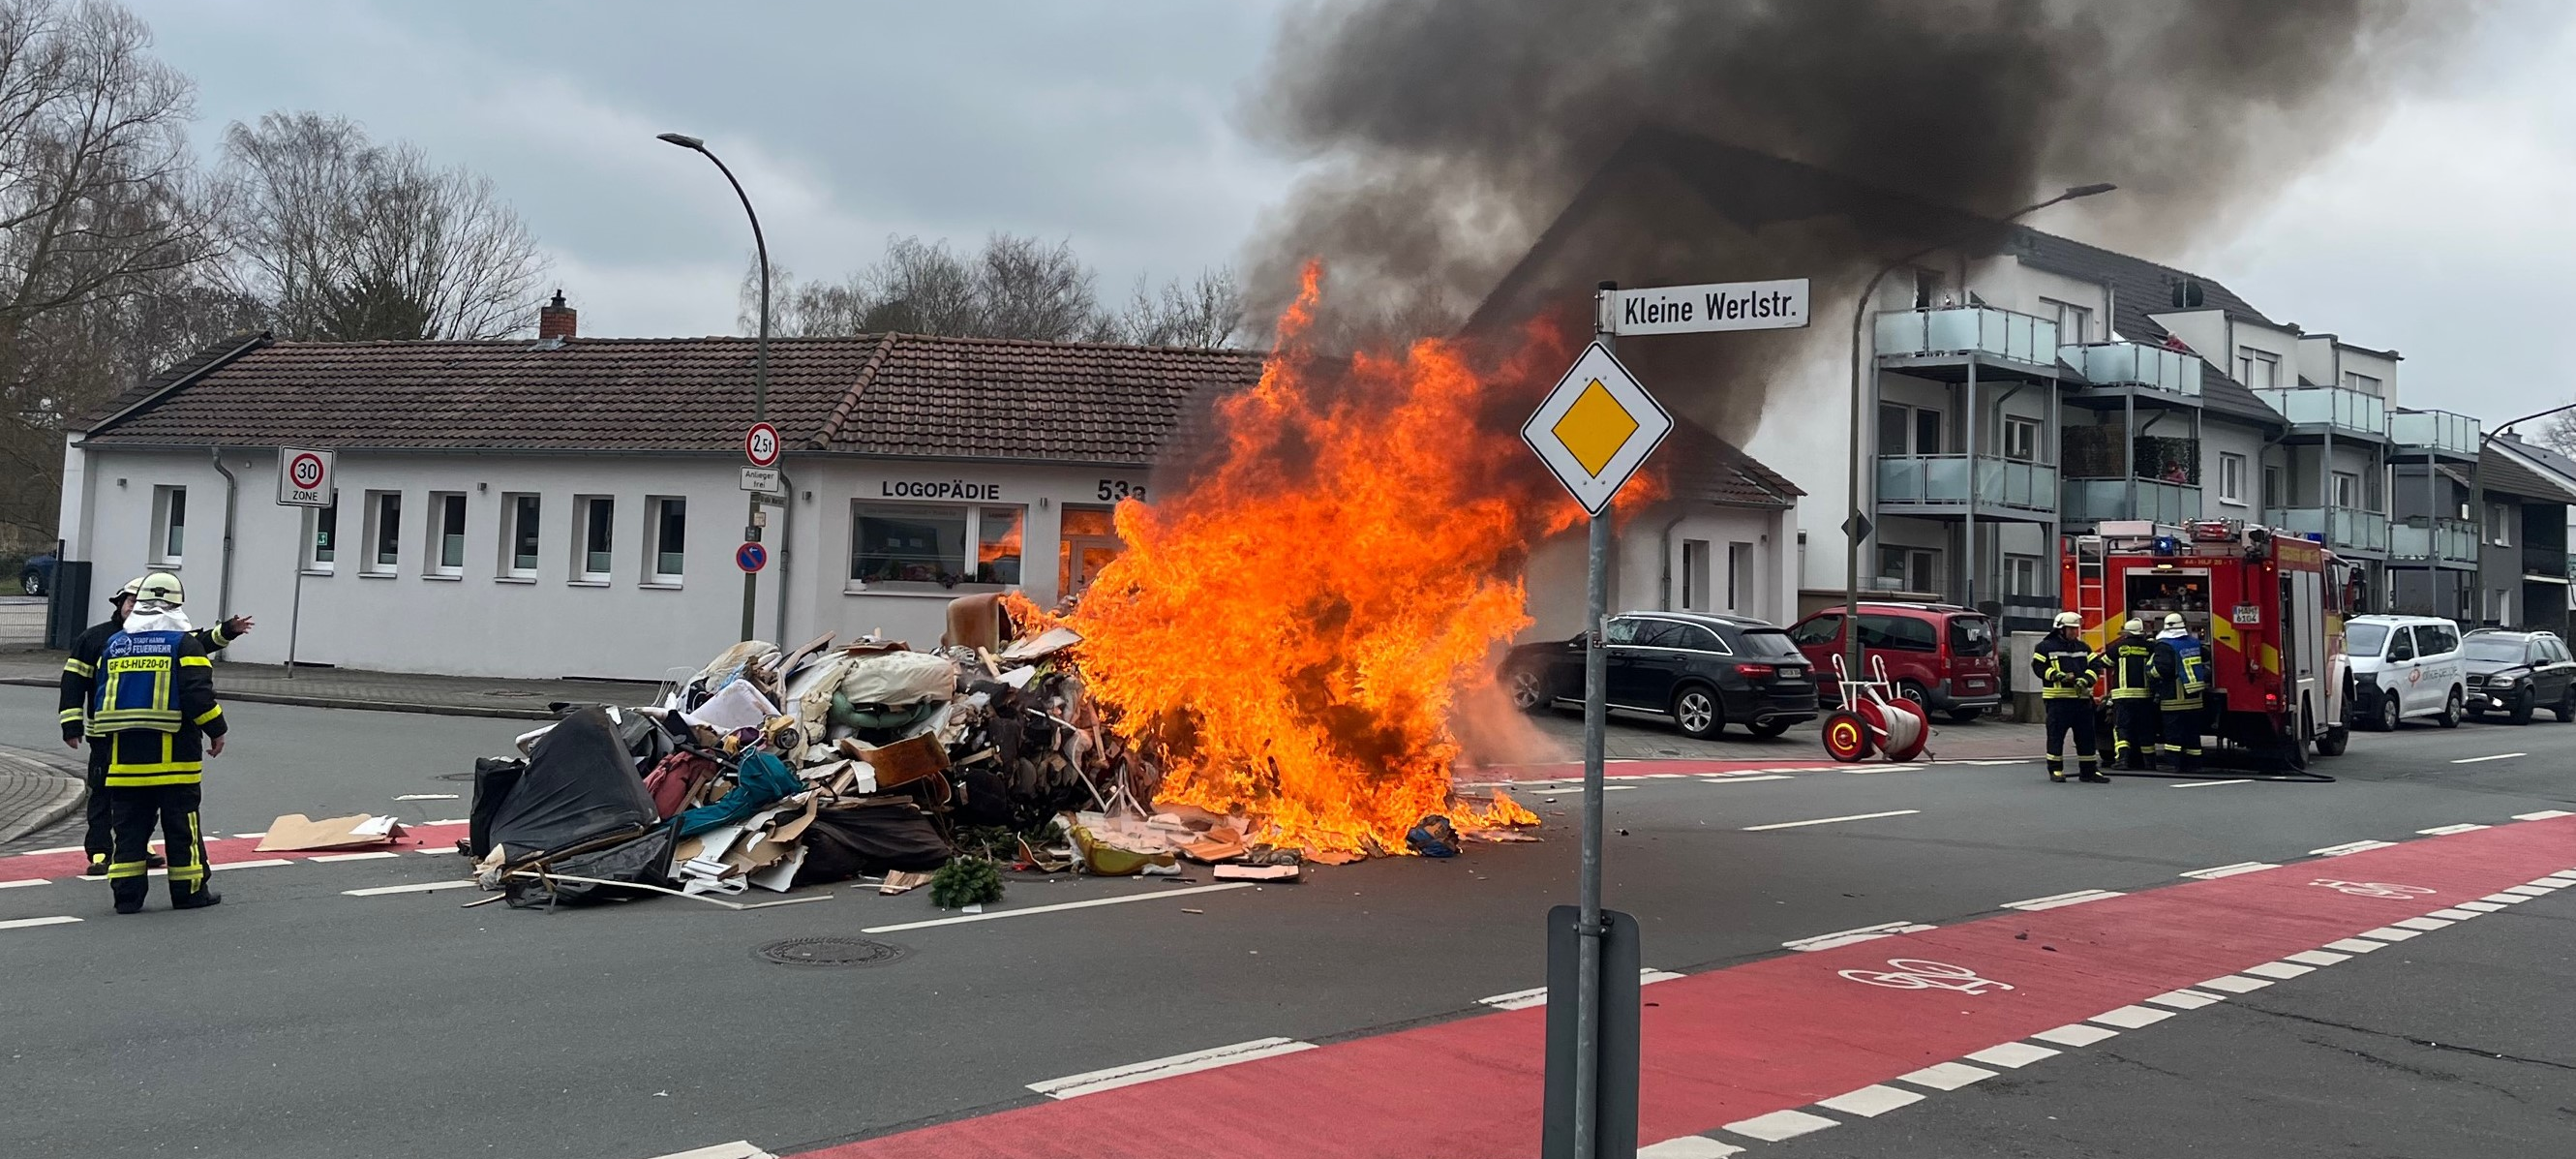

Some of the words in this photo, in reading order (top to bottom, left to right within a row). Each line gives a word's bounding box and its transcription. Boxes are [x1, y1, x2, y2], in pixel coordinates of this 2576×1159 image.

[1624, 295, 1693, 325] Kleine
[1705, 290, 1797, 320] Werlstr.
[753, 434, 773, 453] 2,5t
[297, 462, 318, 480] 30
[744, 471, 774, 480] Anlieger
[292, 490, 318, 502] ZONE
[882, 479, 1000, 500] LOGOPÄDIE
[1097, 478, 1146, 503] 53a
[132, 644, 171, 654] FEUERWEHR
[108, 659, 118, 671] GF
[120, 658, 169, 670] 43-HLF20-01
